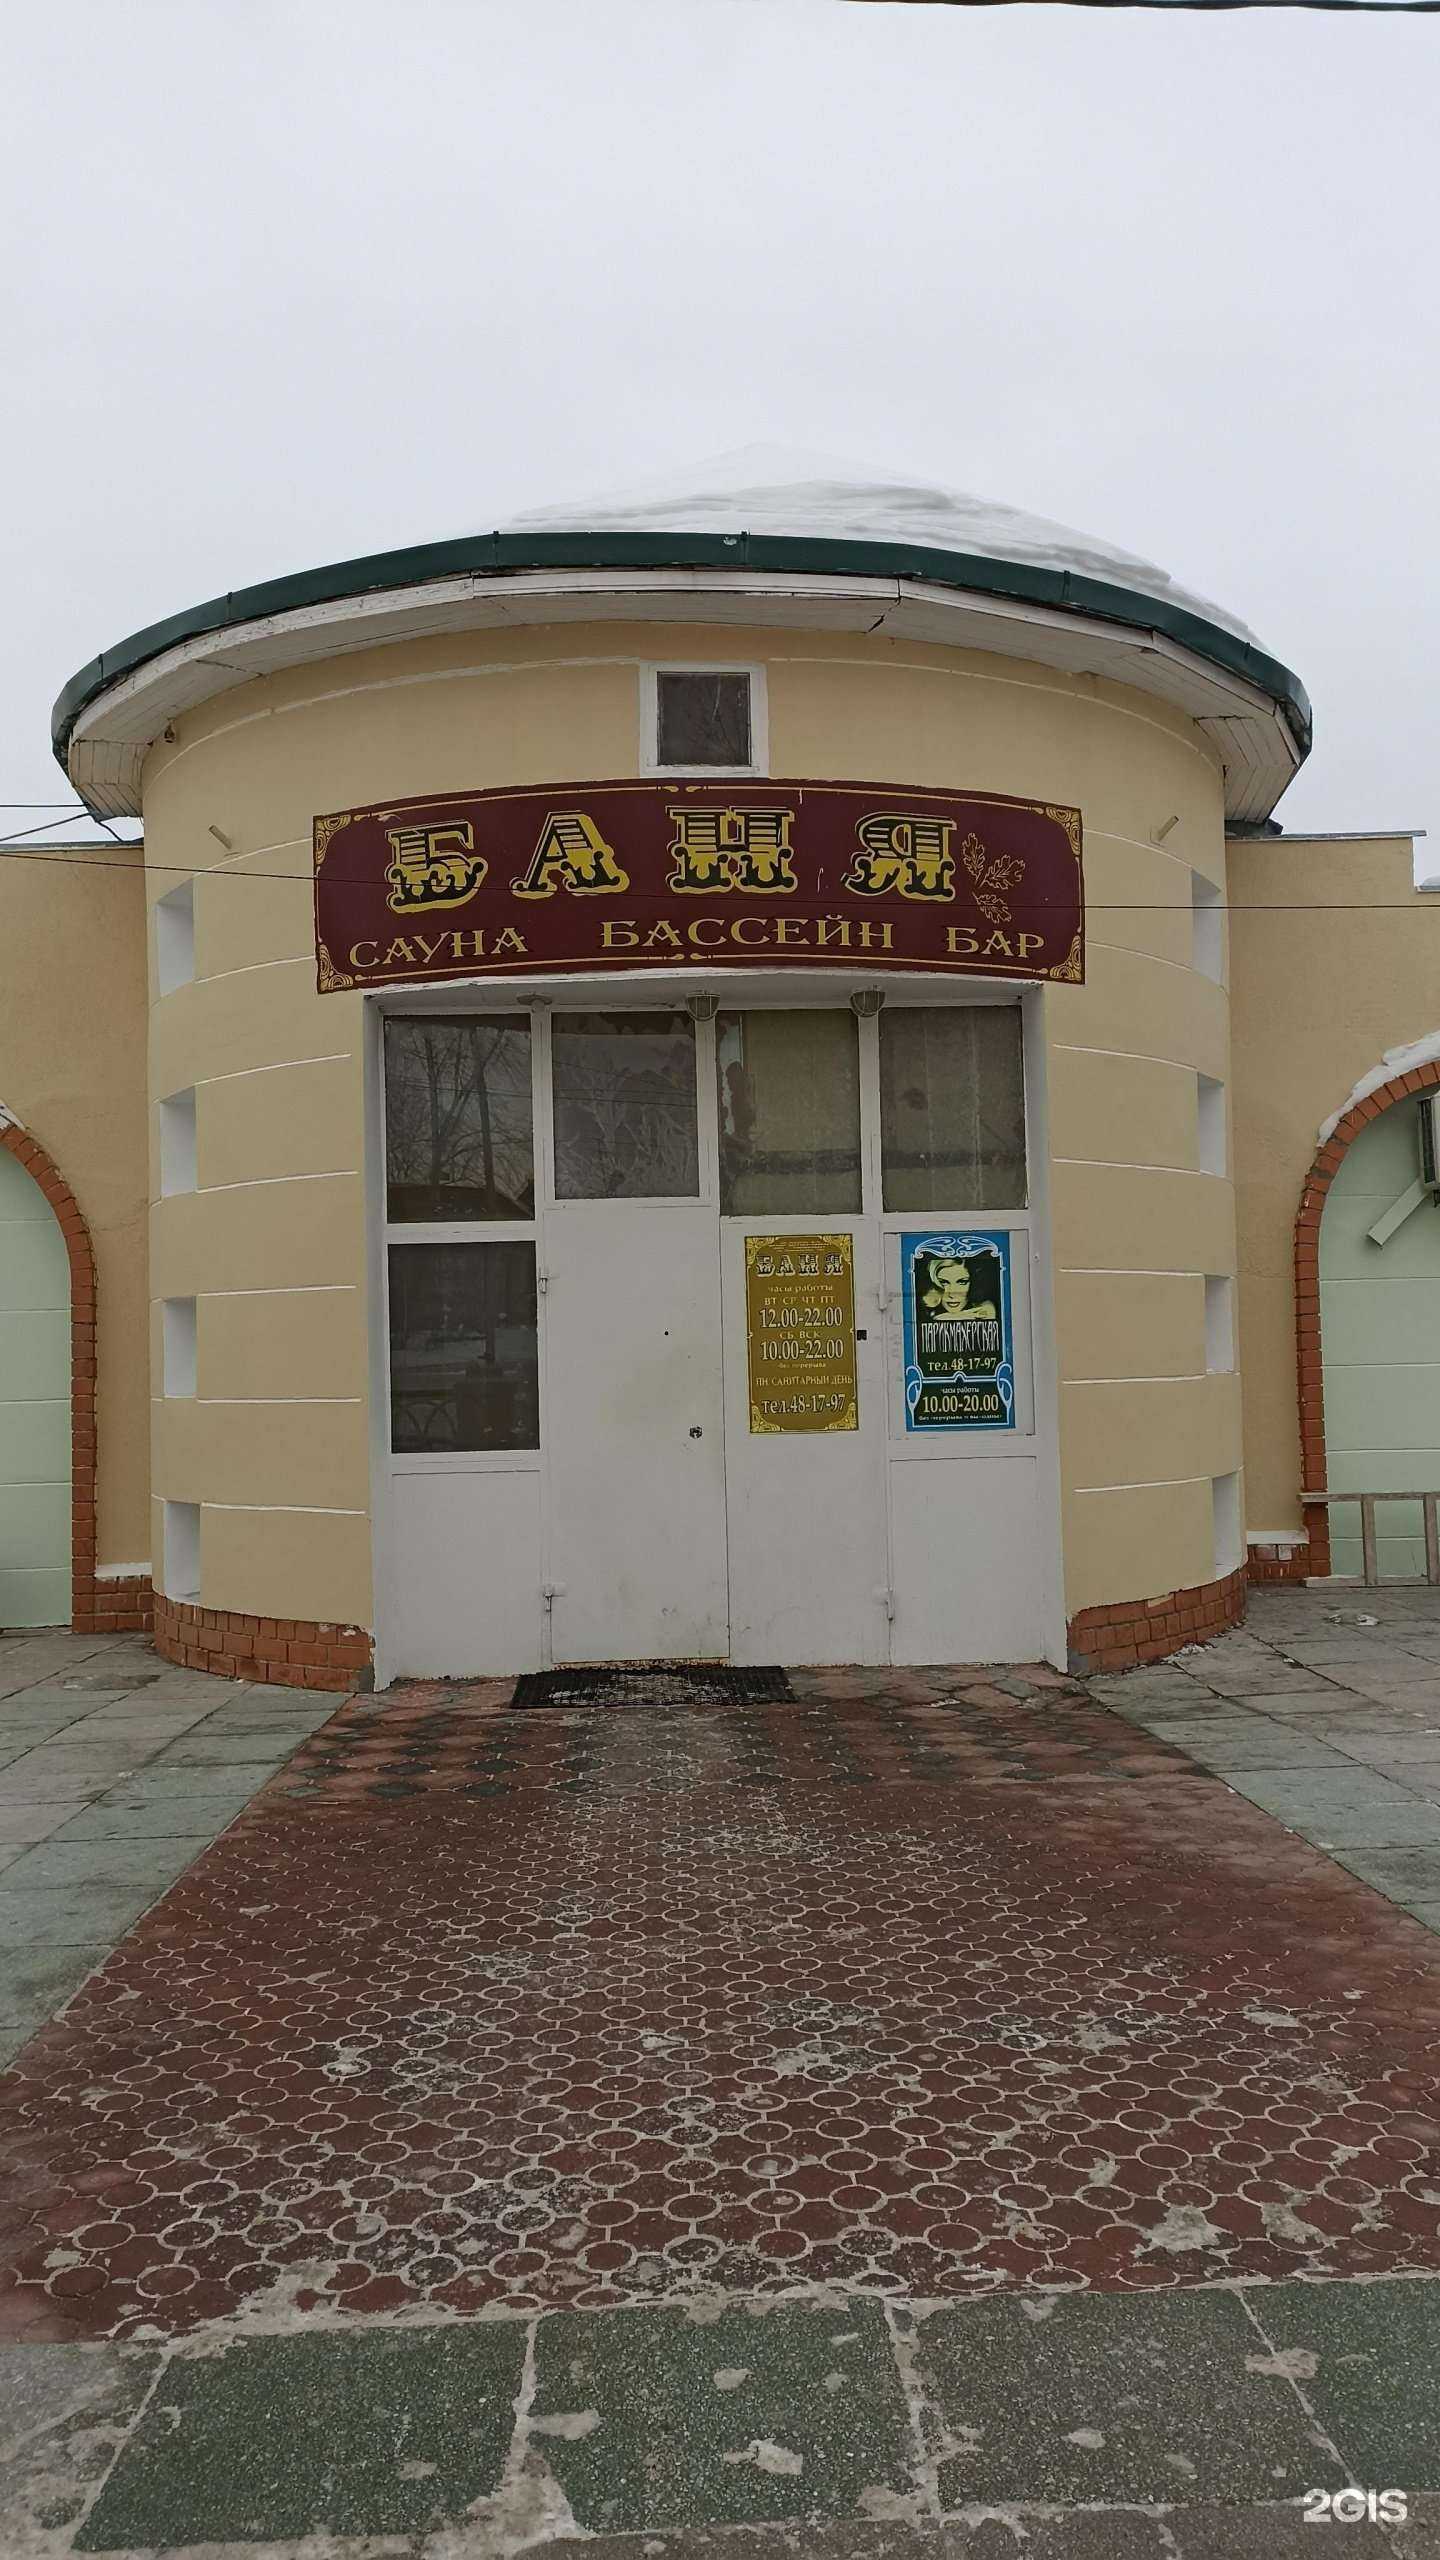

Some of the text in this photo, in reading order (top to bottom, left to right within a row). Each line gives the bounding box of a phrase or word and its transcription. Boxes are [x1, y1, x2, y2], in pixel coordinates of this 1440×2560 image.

[384, 804, 955, 914] БАНЯ
[348, 912, 1046, 970] САУНА БАССЕЙН БАР
[755, 1254, 844, 1278] БАНЯ
[795, 1284, 833, 1294] работы
[764, 1295, 834, 1306] ВТ СР ЧТ ПТ
[759, 1306, 843, 1328] 12.00-22.00
[779, 1330, 822, 1340] СБ ВСК
[921, 1321, 1000, 1353] ПАРИКМАХЕРСКАЯ
[760, 1339, 844, 1361] 10.00-22.00
[927, 1357, 997, 1372] тел.48-17-97
[756, 1377, 769, 1386] ПН
[831, 1374, 853, 1385] ДЕНЬ
[761, 1393, 846, 1414] тел.48-17-97
[922, 1394, 999, 1413] 10.00-20.00
